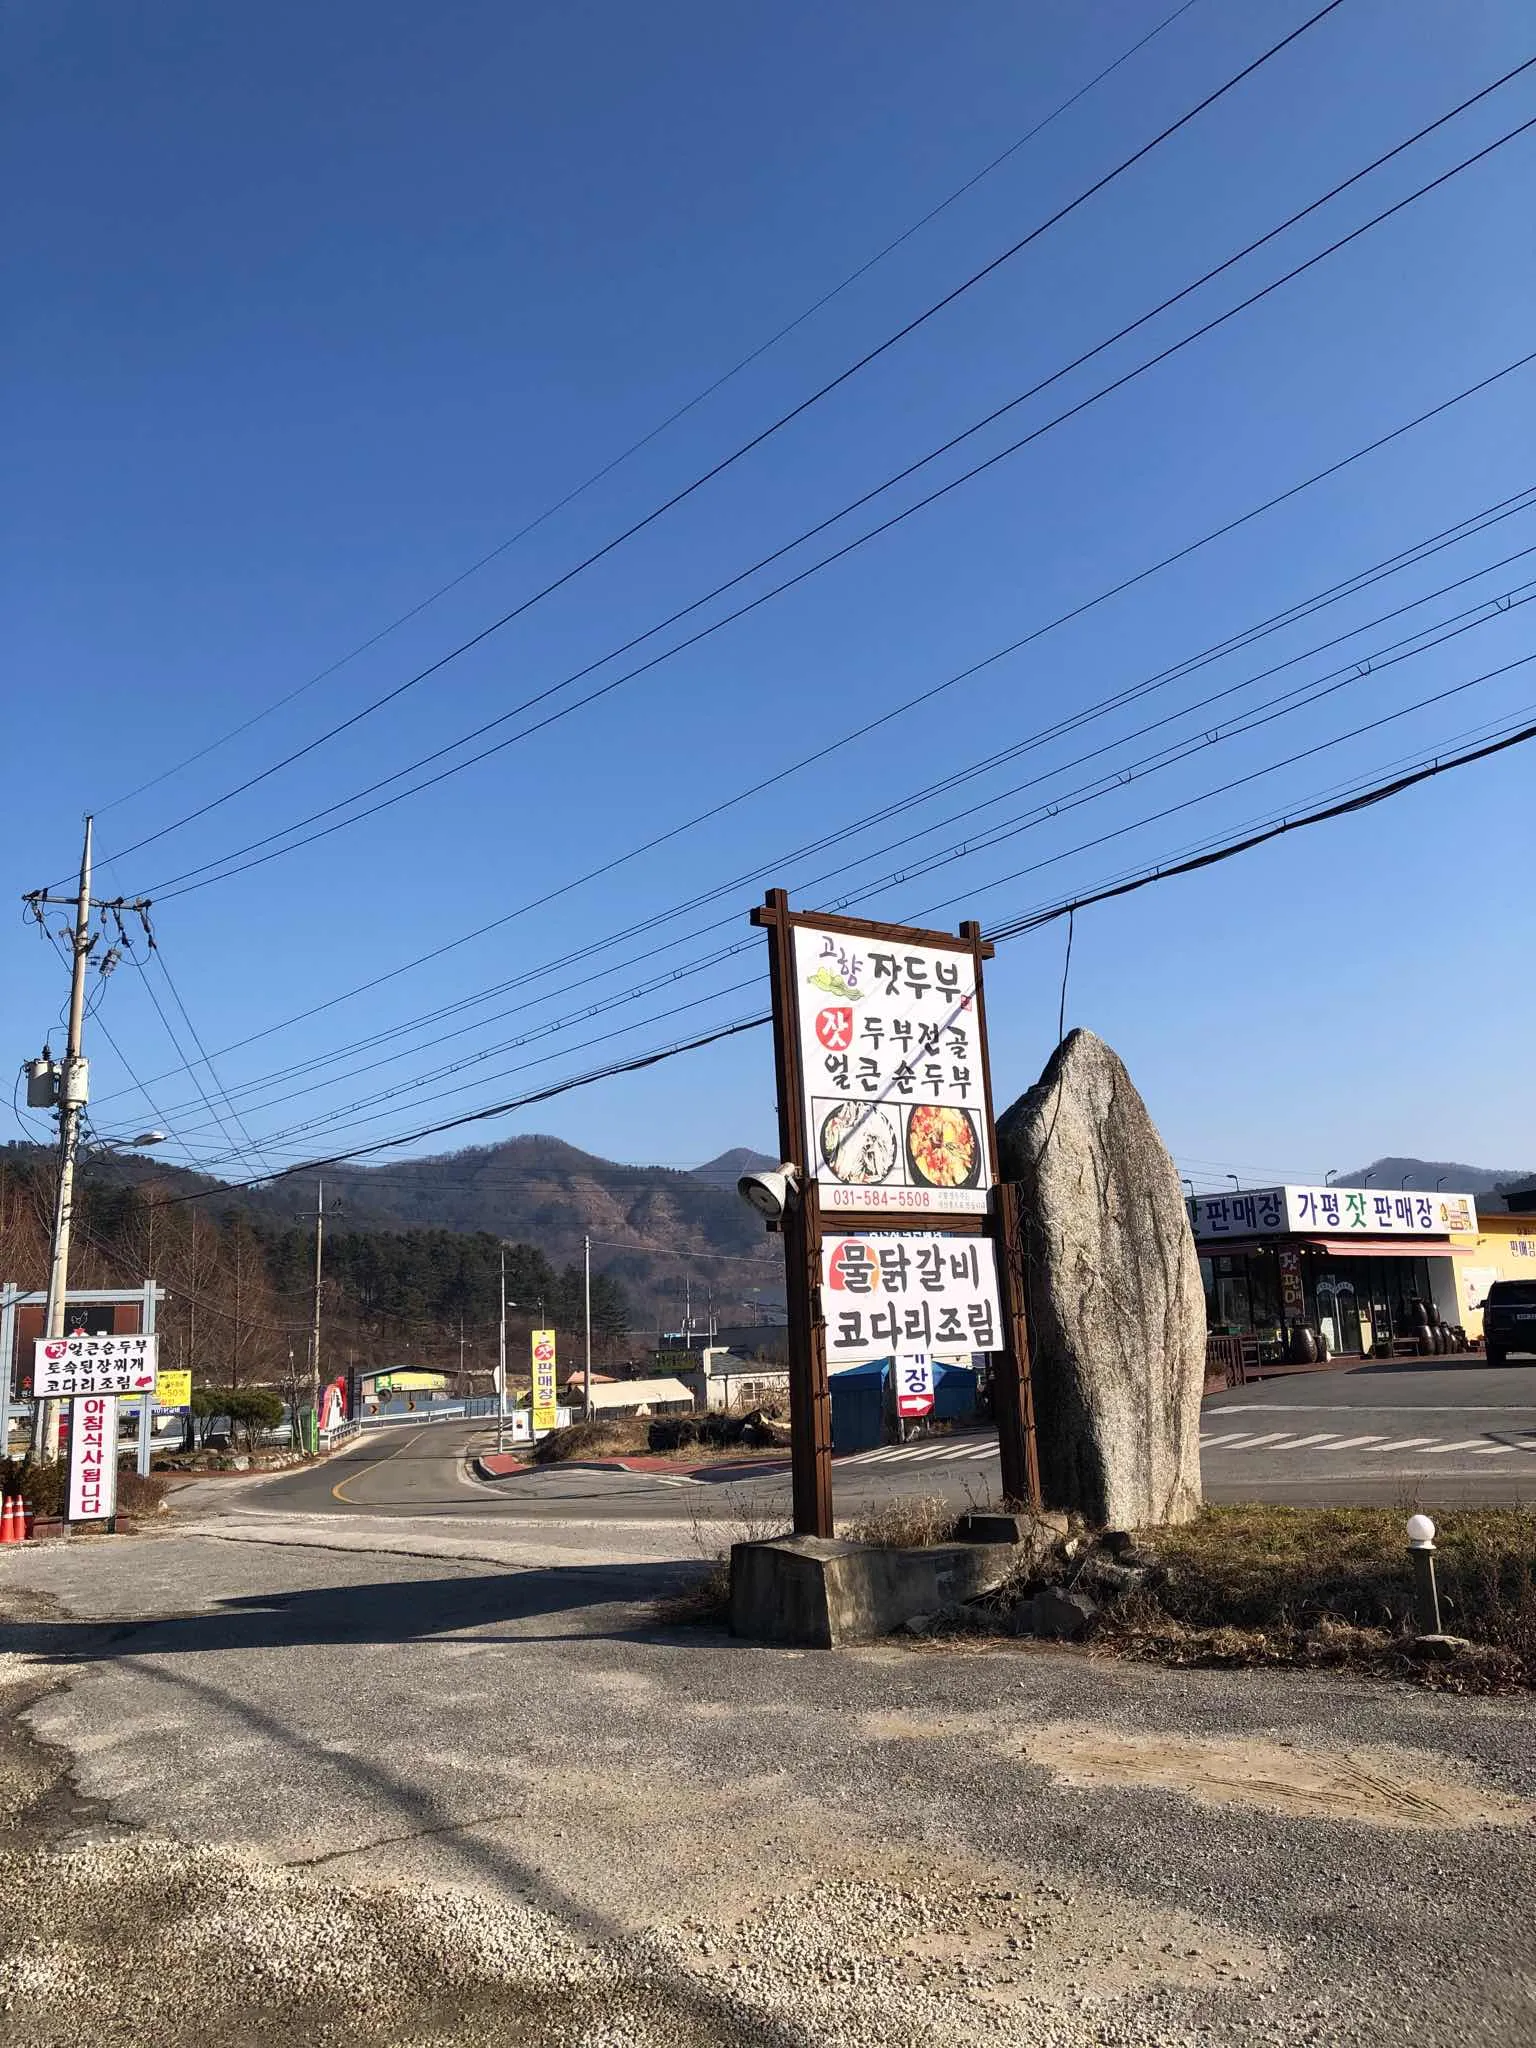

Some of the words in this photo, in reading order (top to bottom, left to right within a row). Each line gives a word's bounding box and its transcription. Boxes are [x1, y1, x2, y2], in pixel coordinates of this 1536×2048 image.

[819, 936, 864, 987] 고향
[868, 953, 962, 1004] 잣두부
[822, 1011, 847, 1048] 잣
[860, 1017, 969, 1060] 두부전골
[833, 1189, 930, 1208] 031-584-5508
[1206, 1192, 1282, 1232] 판매장
[1297, 1193, 1340, 1227] 가평
[1345, 1193, 1367, 1229] 잣
[1374, 1196, 1433, 1229] 판매장
[837, 1243, 980, 1293] 물닭갈비
[833, 1299, 994, 1348] 코다리조림
[44, 1375, 131, 1393] 코다리조림
[538, 1363, 554, 1399] 판매장
